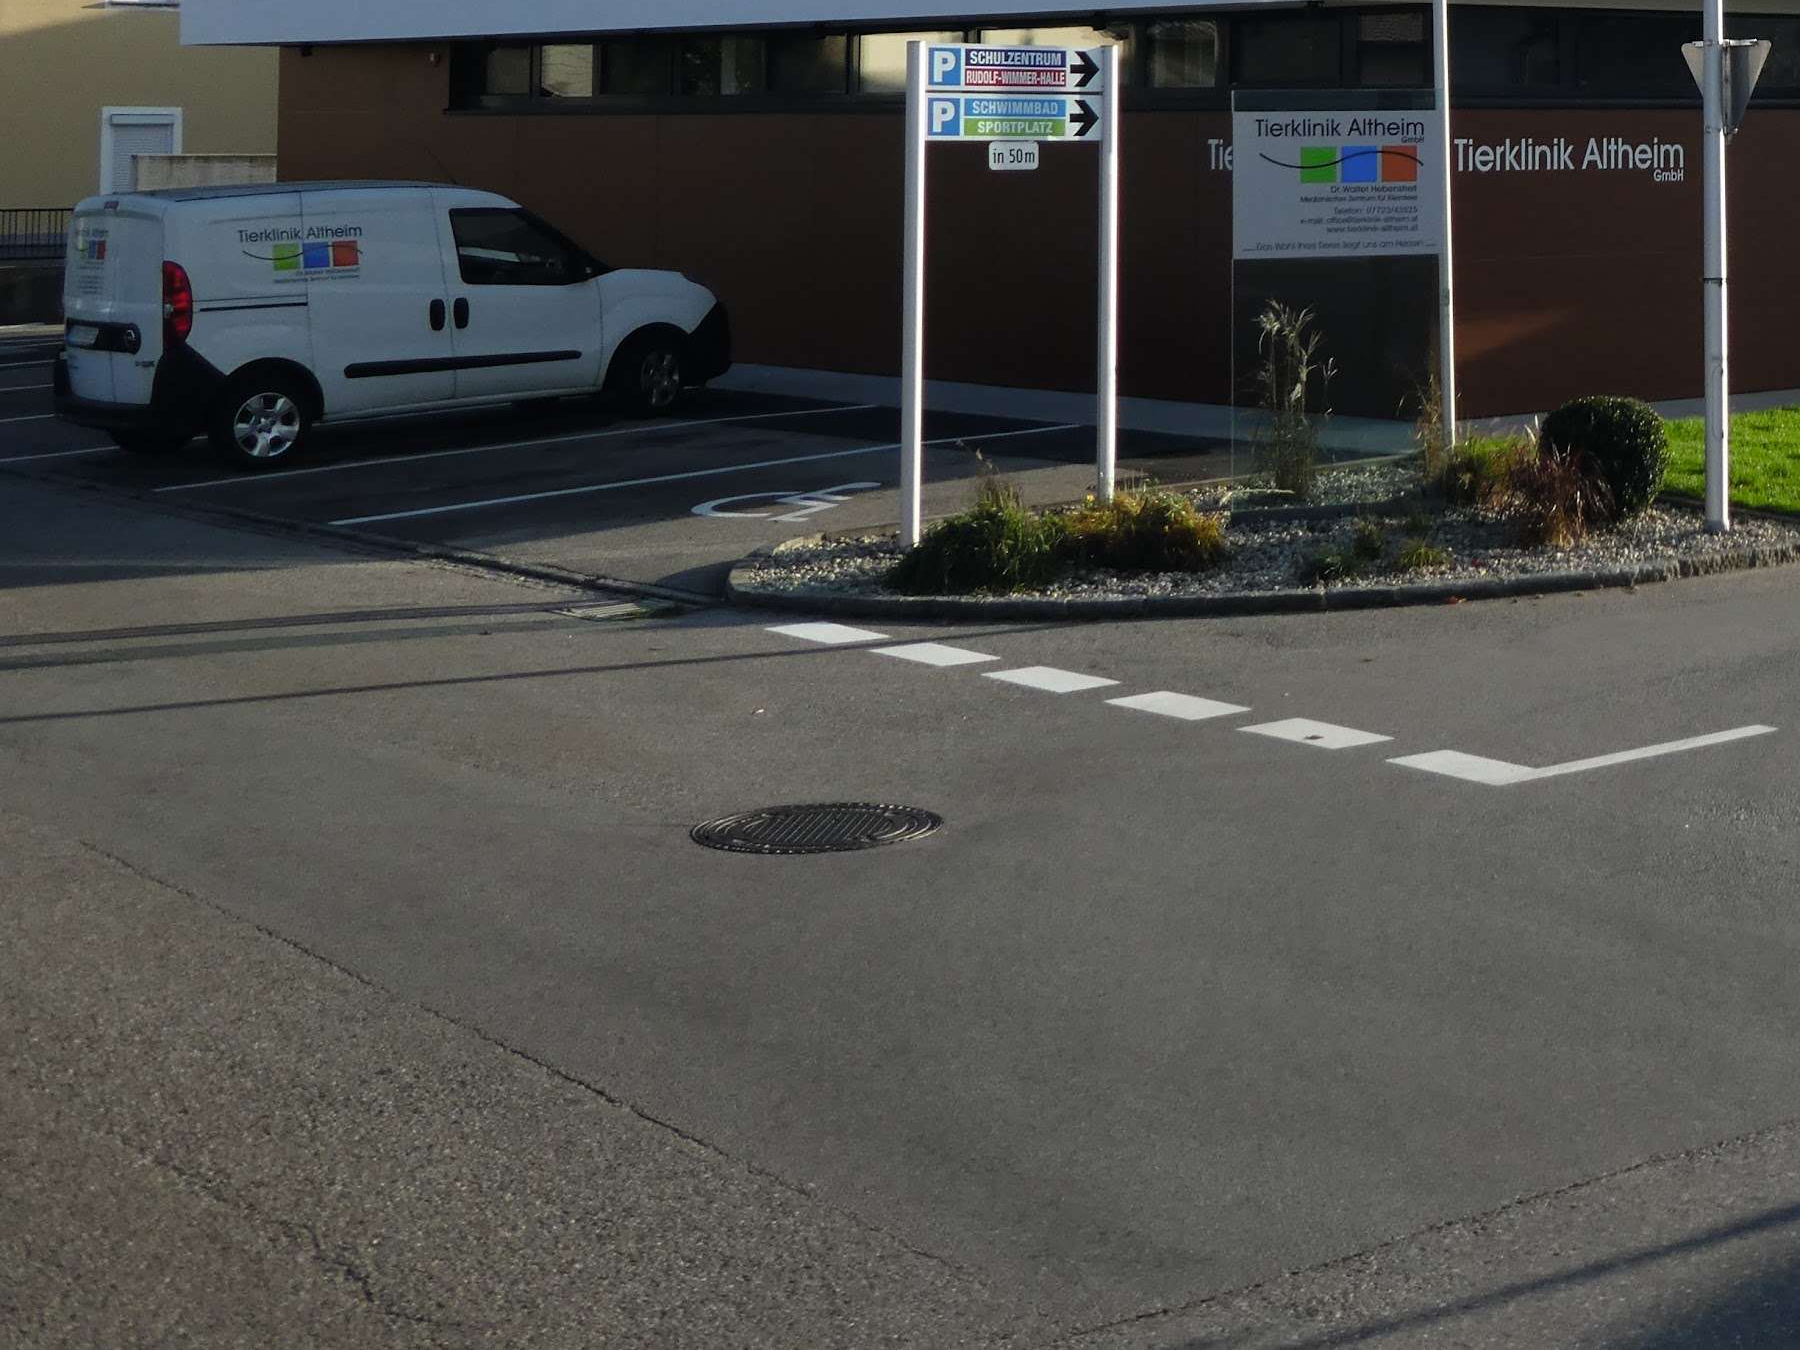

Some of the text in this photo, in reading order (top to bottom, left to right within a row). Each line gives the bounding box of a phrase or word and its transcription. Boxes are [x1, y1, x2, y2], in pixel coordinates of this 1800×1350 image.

[933, 50, 1062, 83] P SCHULZENTRUM
[966, 70, 1066, 86] RUDOLF-WIMMER-HALLE
[932, 100, 1059, 133] P SCHWIMMBAD
[977, 120, 1054, 134] SPORTPLATZ
[1255, 117, 1425, 138] Tierklinik Altheim
[992, 148, 1004, 165] in
[1454, 137, 1685, 172] Tierklinik Altheim
[1653, 169, 1685, 182] GmbH
[238, 224, 363, 243] Tierklinik Altheim
